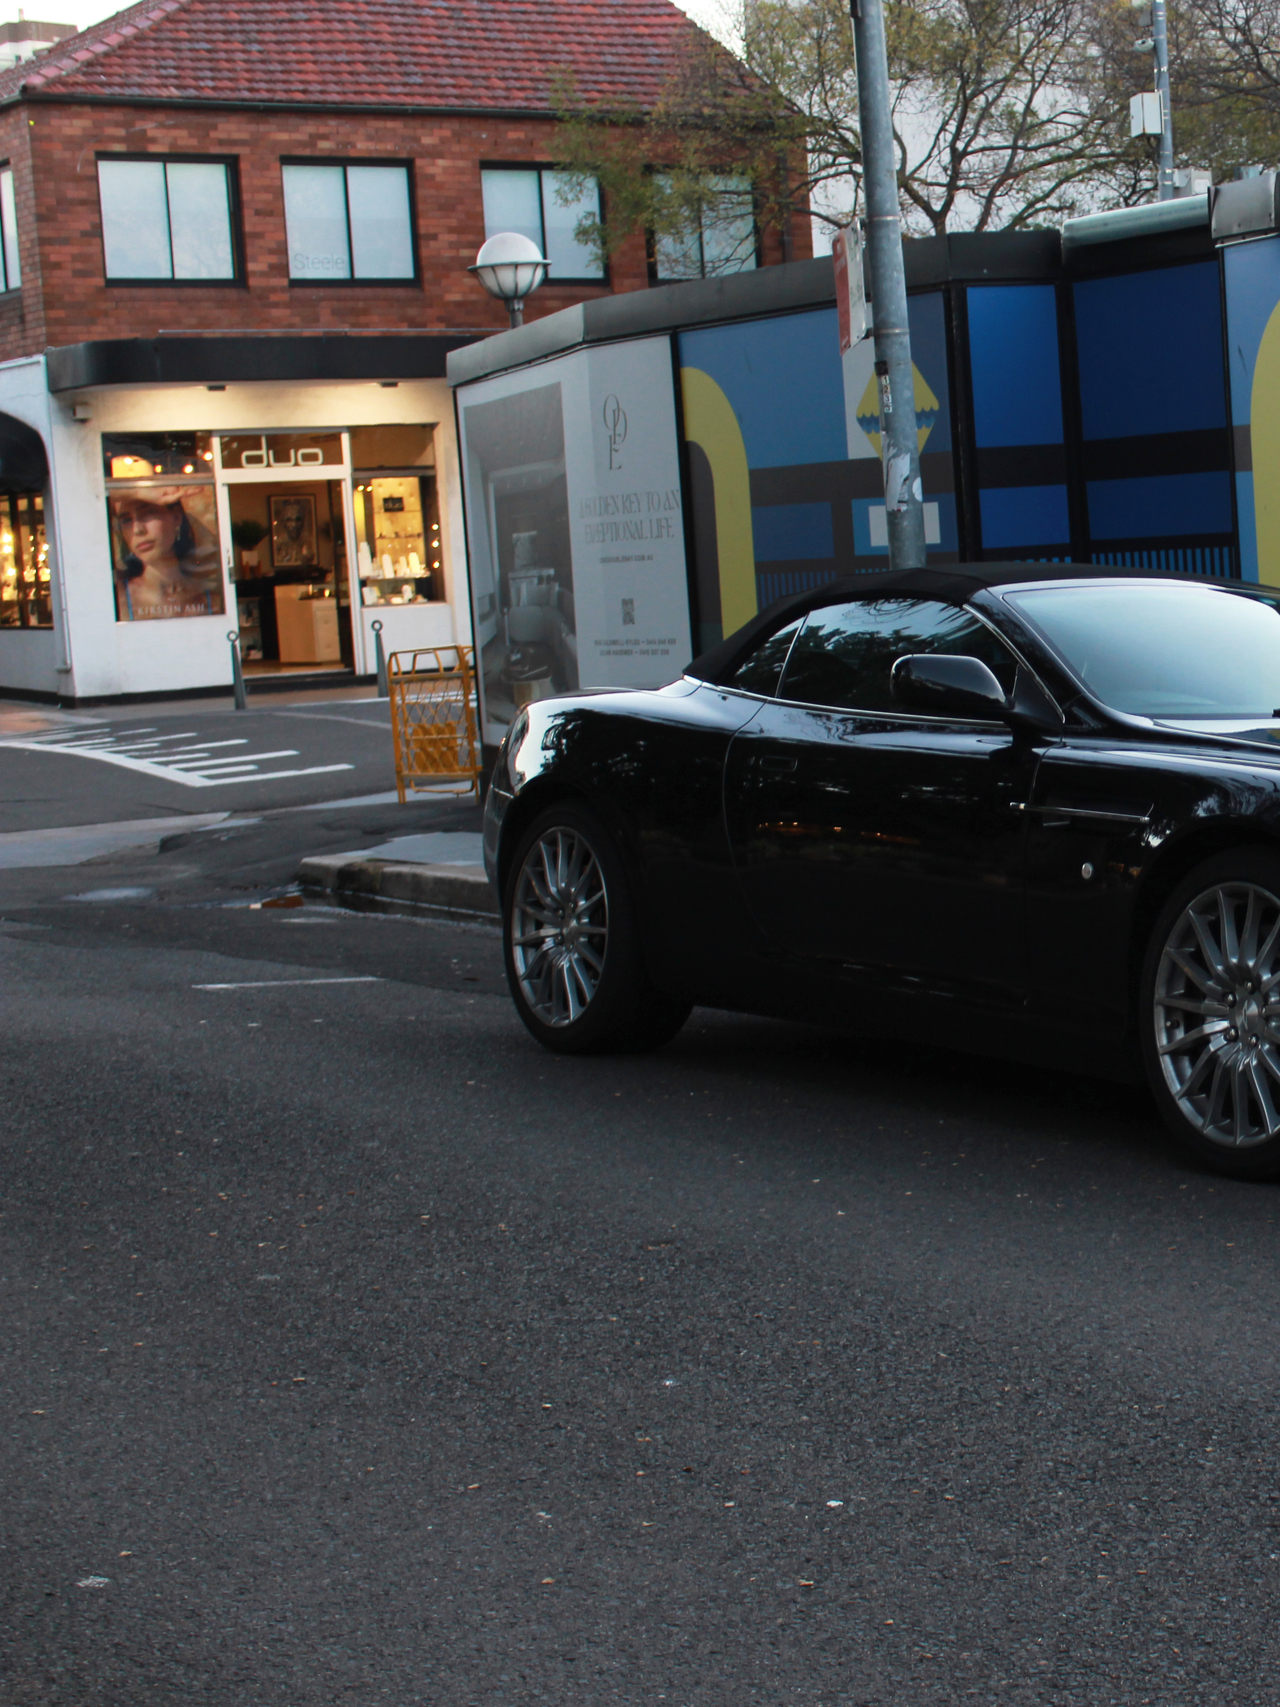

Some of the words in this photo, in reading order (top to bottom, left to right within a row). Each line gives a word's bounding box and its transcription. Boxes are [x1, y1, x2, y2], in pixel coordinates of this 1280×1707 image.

[293, 253, 346, 271] Steele
[241, 434, 324, 469] duo
[621, 492, 642, 514] KEY
[645, 491, 661, 512] TO
[649, 517, 676, 539] LIFE
[138, 604, 182, 615] KIRSTIN
[185, 603, 206, 612] ASH
